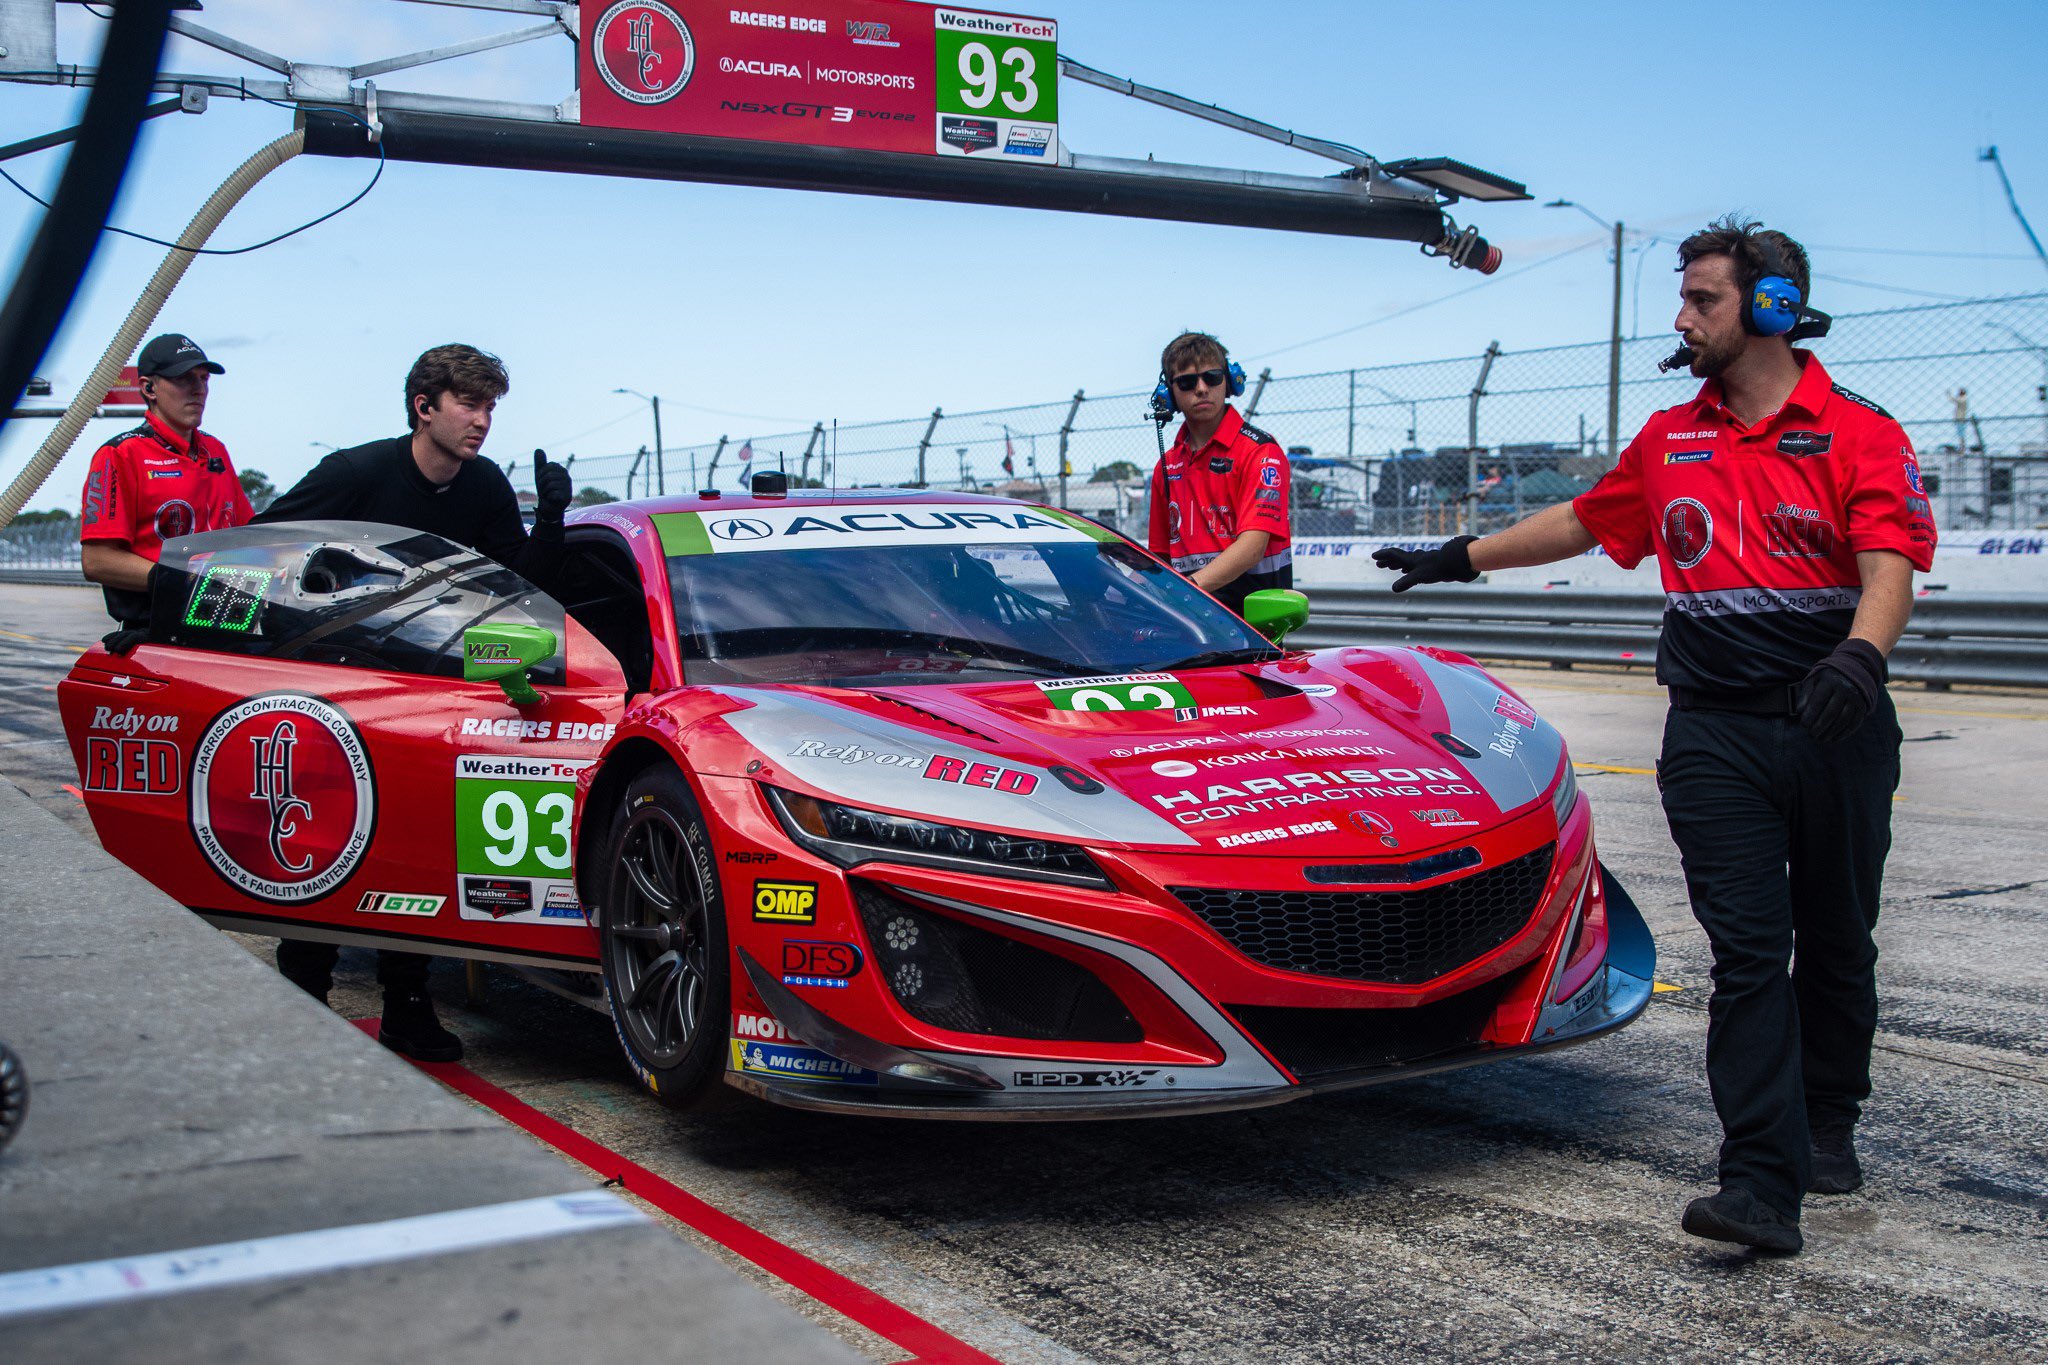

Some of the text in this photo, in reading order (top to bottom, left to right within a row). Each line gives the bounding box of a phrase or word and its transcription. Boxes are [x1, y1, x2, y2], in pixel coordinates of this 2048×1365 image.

[730, 10, 786, 29] RACERS
[790, 17, 826, 33] EDGE
[846, 20, 890, 40] WTR
[940, 13, 1053, 37] WeatherTech
[733, 60, 915, 89] ACURA MOTORSPORTS
[958, 42, 1039, 113] 93
[1839, 389, 1880, 413] ACURA
[1666, 430, 1718, 440] RACERS EDGE
[1677, 453, 1709, 461] MICHELIN
[1774, 502, 1819, 518] Rely on
[783, 512, 1070, 535] ACURA
[1743, 593, 1851, 609] MOTORSPORTS
[467, 643, 510, 658] WTR
[1041, 674, 1172, 688] WeatherTech
[90, 706, 179, 737] Rely on
[1202, 706, 1258, 717] IMSA
[197, 698, 367, 781] HARRISON CONTRACTING COMPANY
[461, 718, 617, 741] RACERS EDGE
[1134, 729, 1371, 755] ACURA MOTORSPORTS
[1488, 732, 1524, 759] Rely
[85, 737, 181, 795] RED
[787, 740, 1041, 796] Rely on RED
[1198, 746, 1396, 769] KONICA MINOLTA
[1151, 767, 1463, 810] HARRISON
[1175, 784, 1482, 825] CONTRACTING CO.
[1409, 809, 1464, 822] WTR
[482, 790, 574, 870] 93
[1216, 820, 1338, 848] RACERS EDGE
[198, 826, 366, 897] PAINTING & FACILITY MAINTENANCE
[726, 852, 778, 864] MBRP
[384, 896, 438, 913] GTD
[467, 889, 529, 899] WeatherTech
[756, 889, 814, 914] OMP
[783, 944, 847, 974] DFS
[784, 977, 845, 987] POLISH
[769, 1055, 863, 1075] MICHELIN
[1016, 1072, 1083, 1086] HPD
